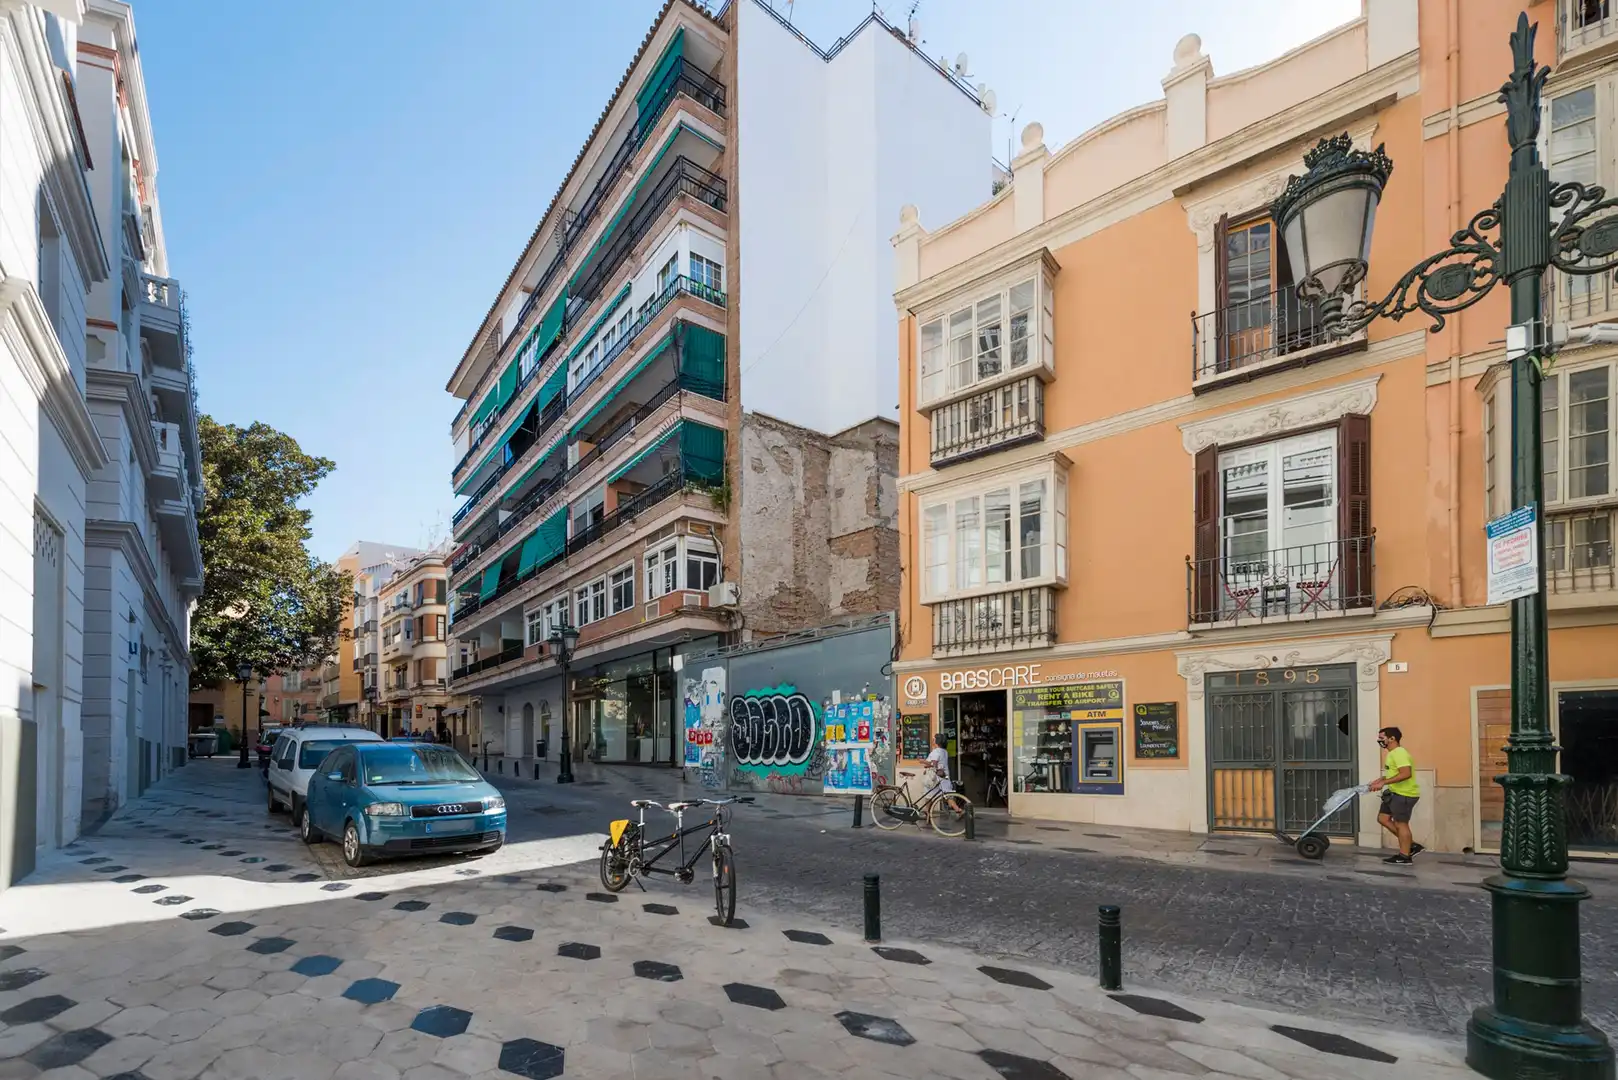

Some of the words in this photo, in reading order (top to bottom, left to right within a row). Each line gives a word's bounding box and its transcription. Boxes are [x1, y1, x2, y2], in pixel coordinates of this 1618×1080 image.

[941, 664, 1042, 690] BAGSCARE
[1045, 674, 1076, 682] consigna
[1087, 671, 1118, 679] maletas
[1235, 668, 1320, 687] 1895
[1066, 684, 1096, 692] SUITCASE
[1037, 692, 1062, 700] RENT
[1063, 691, 1070, 699] A
[1072, 690, 1095, 698] BIKE
[1027, 699, 1063, 707] TRANSFER
[1074, 697, 1106, 705] AIRPORT
[1086, 710, 1107, 718] ATM
